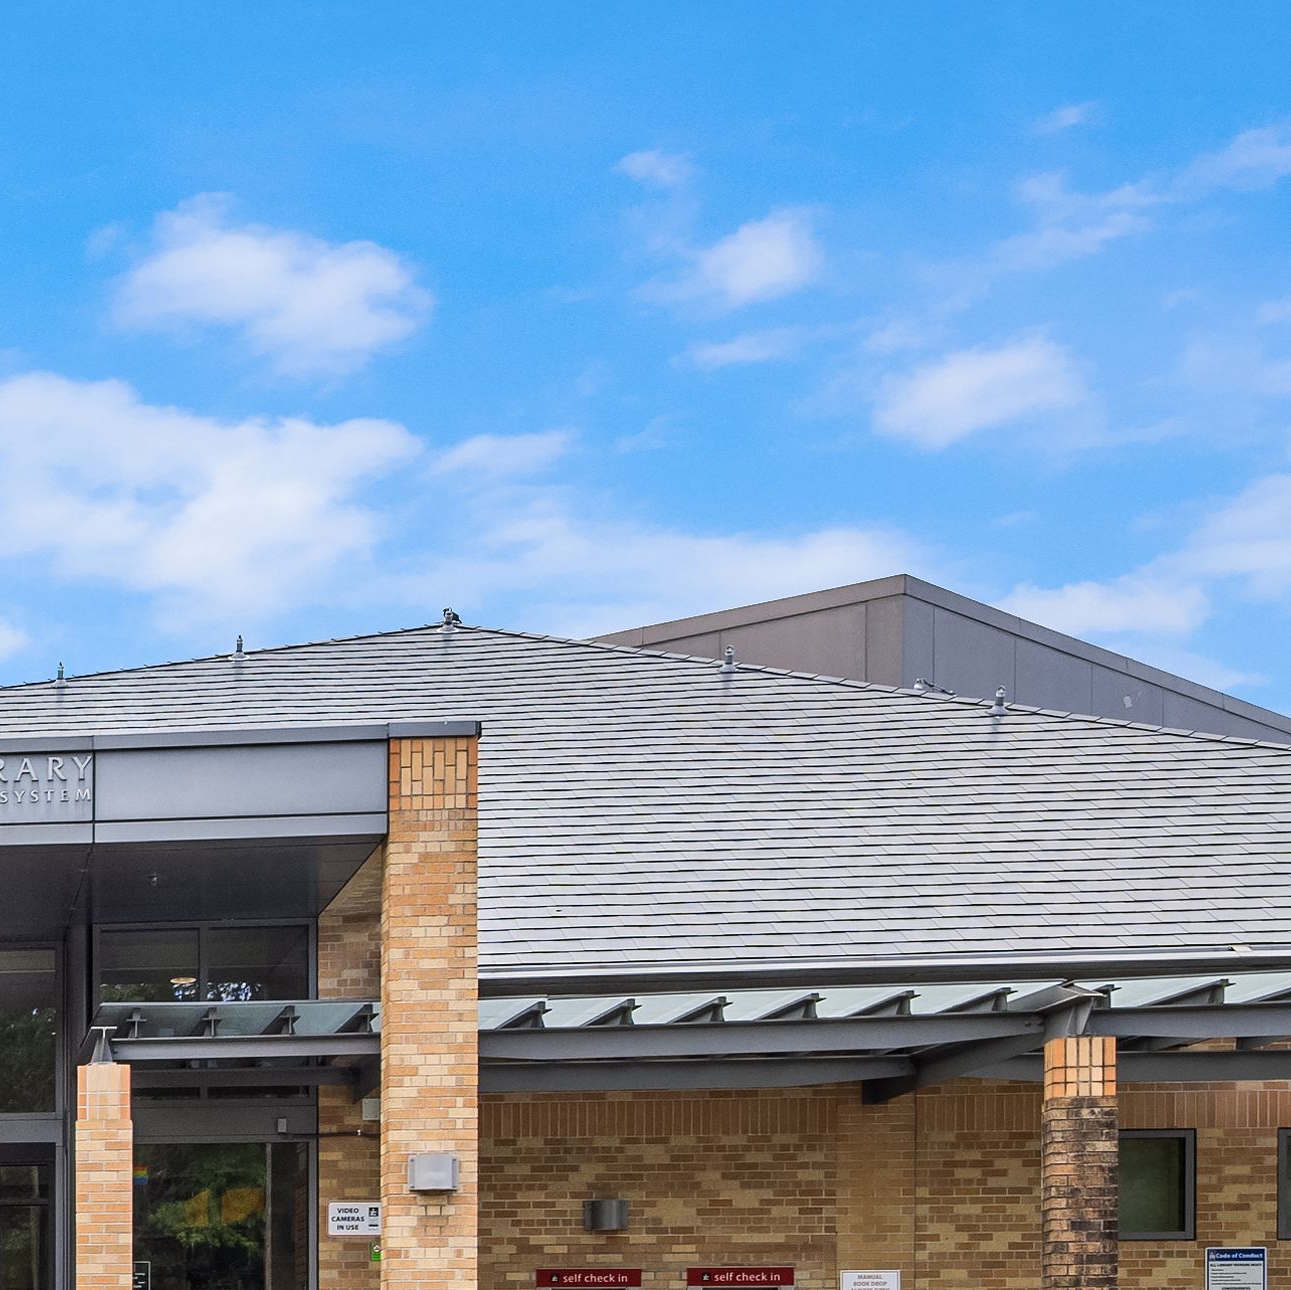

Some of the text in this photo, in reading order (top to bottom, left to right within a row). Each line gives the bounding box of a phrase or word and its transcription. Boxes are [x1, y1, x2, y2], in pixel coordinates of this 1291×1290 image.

[0, 788, 92, 804] SYSTEM
[563, 1273, 628, 1283] self check in
[714, 1272, 781, 1282] self check in
